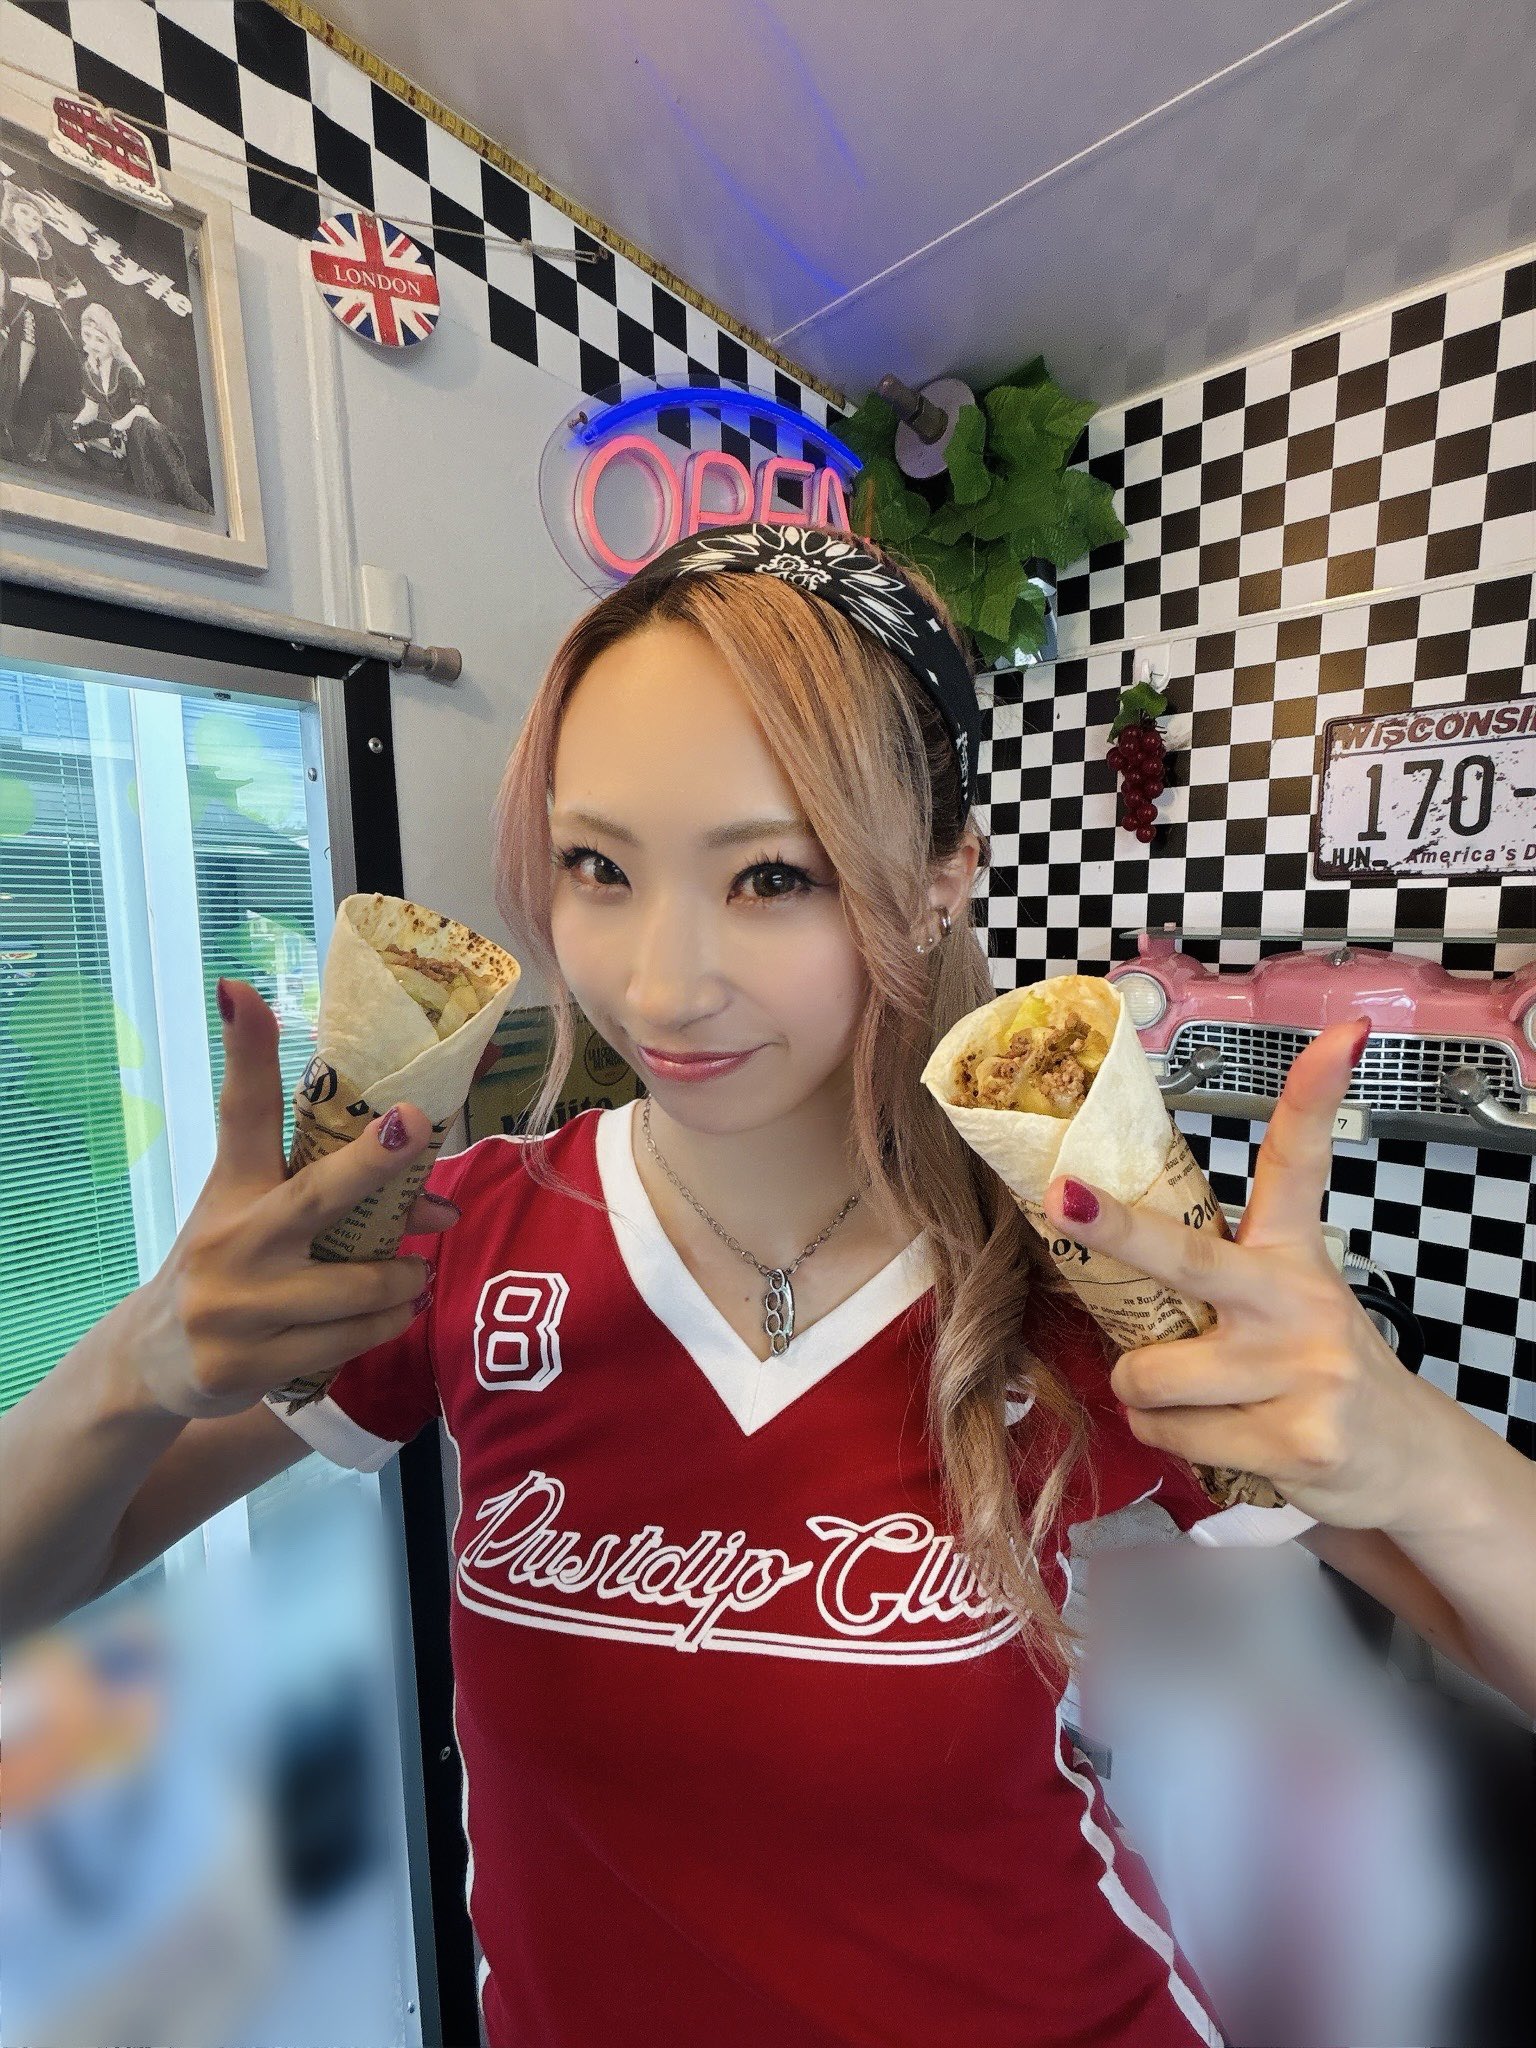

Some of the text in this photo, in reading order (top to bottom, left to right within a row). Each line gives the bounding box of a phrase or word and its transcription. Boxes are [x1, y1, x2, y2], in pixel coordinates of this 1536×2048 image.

[333, 264, 422, 297] LONDON
[1337, 704, 1536, 751] WISCONSI
[1406, 844, 1517, 864] America's
[1337, 1118, 1348, 1130] 7
[473, 1269, 570, 1392] 8
[805, 1511, 1025, 1637] Clu
